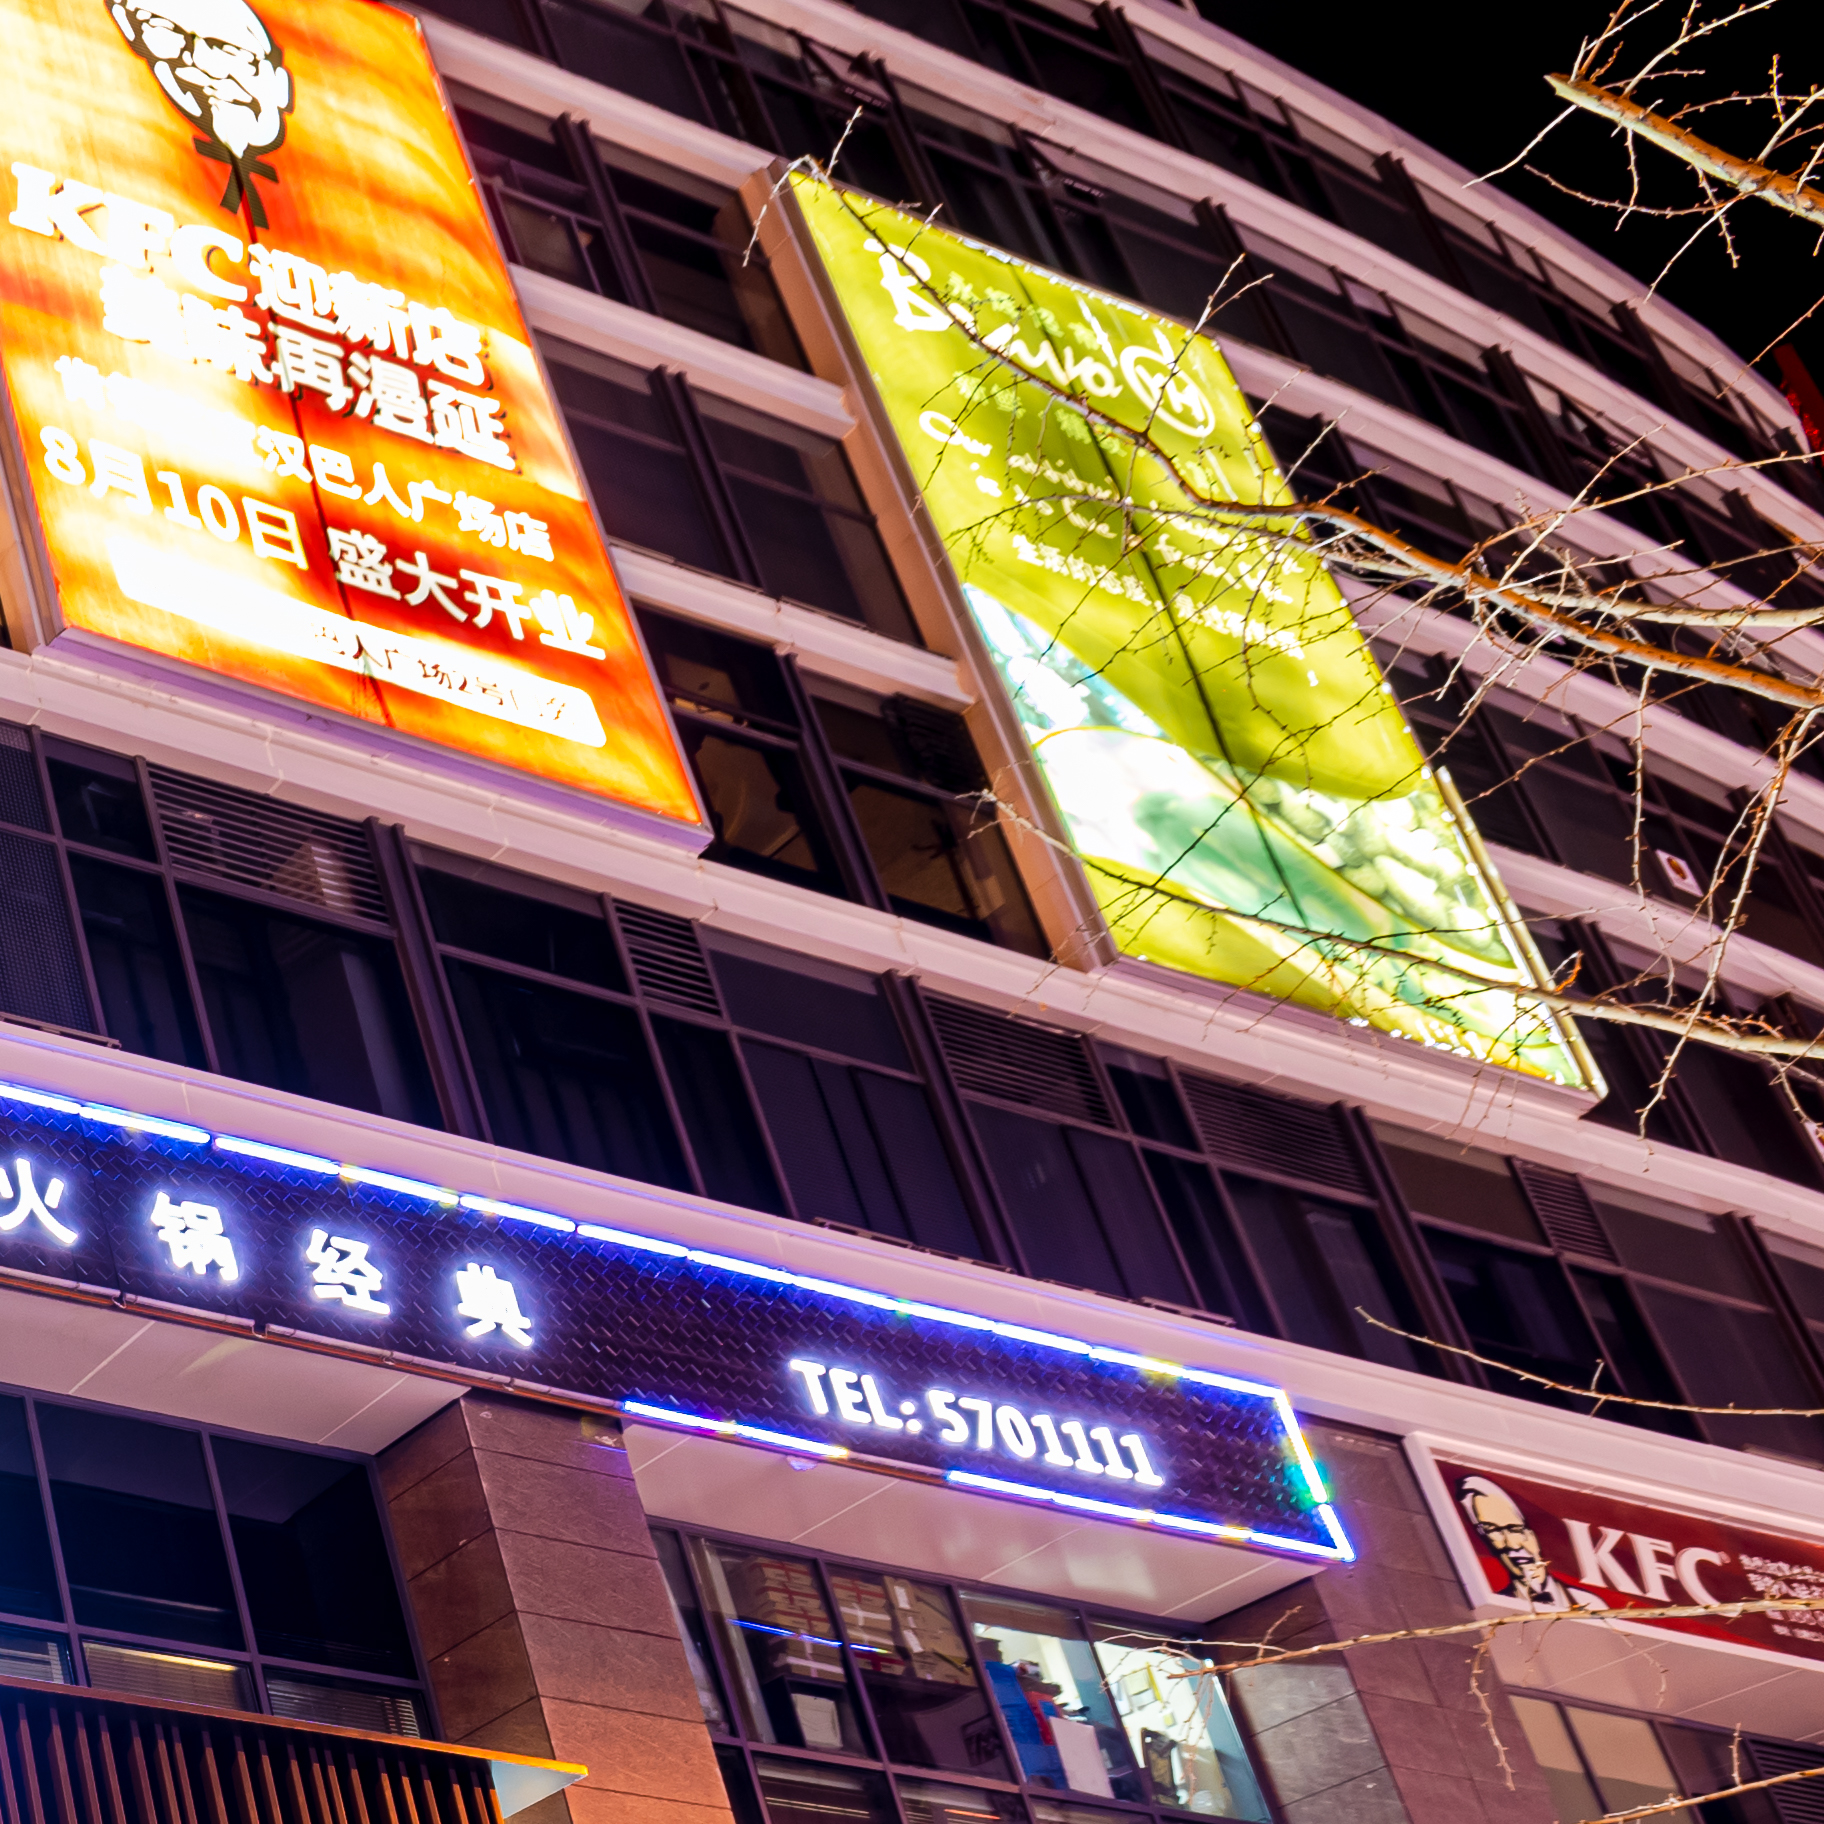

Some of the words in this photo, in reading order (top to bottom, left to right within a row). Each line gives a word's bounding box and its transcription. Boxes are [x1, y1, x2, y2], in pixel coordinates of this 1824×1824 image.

[328, 526, 607, 662] 盛大开业
[1562, 1518, 1741, 1617] KFC
